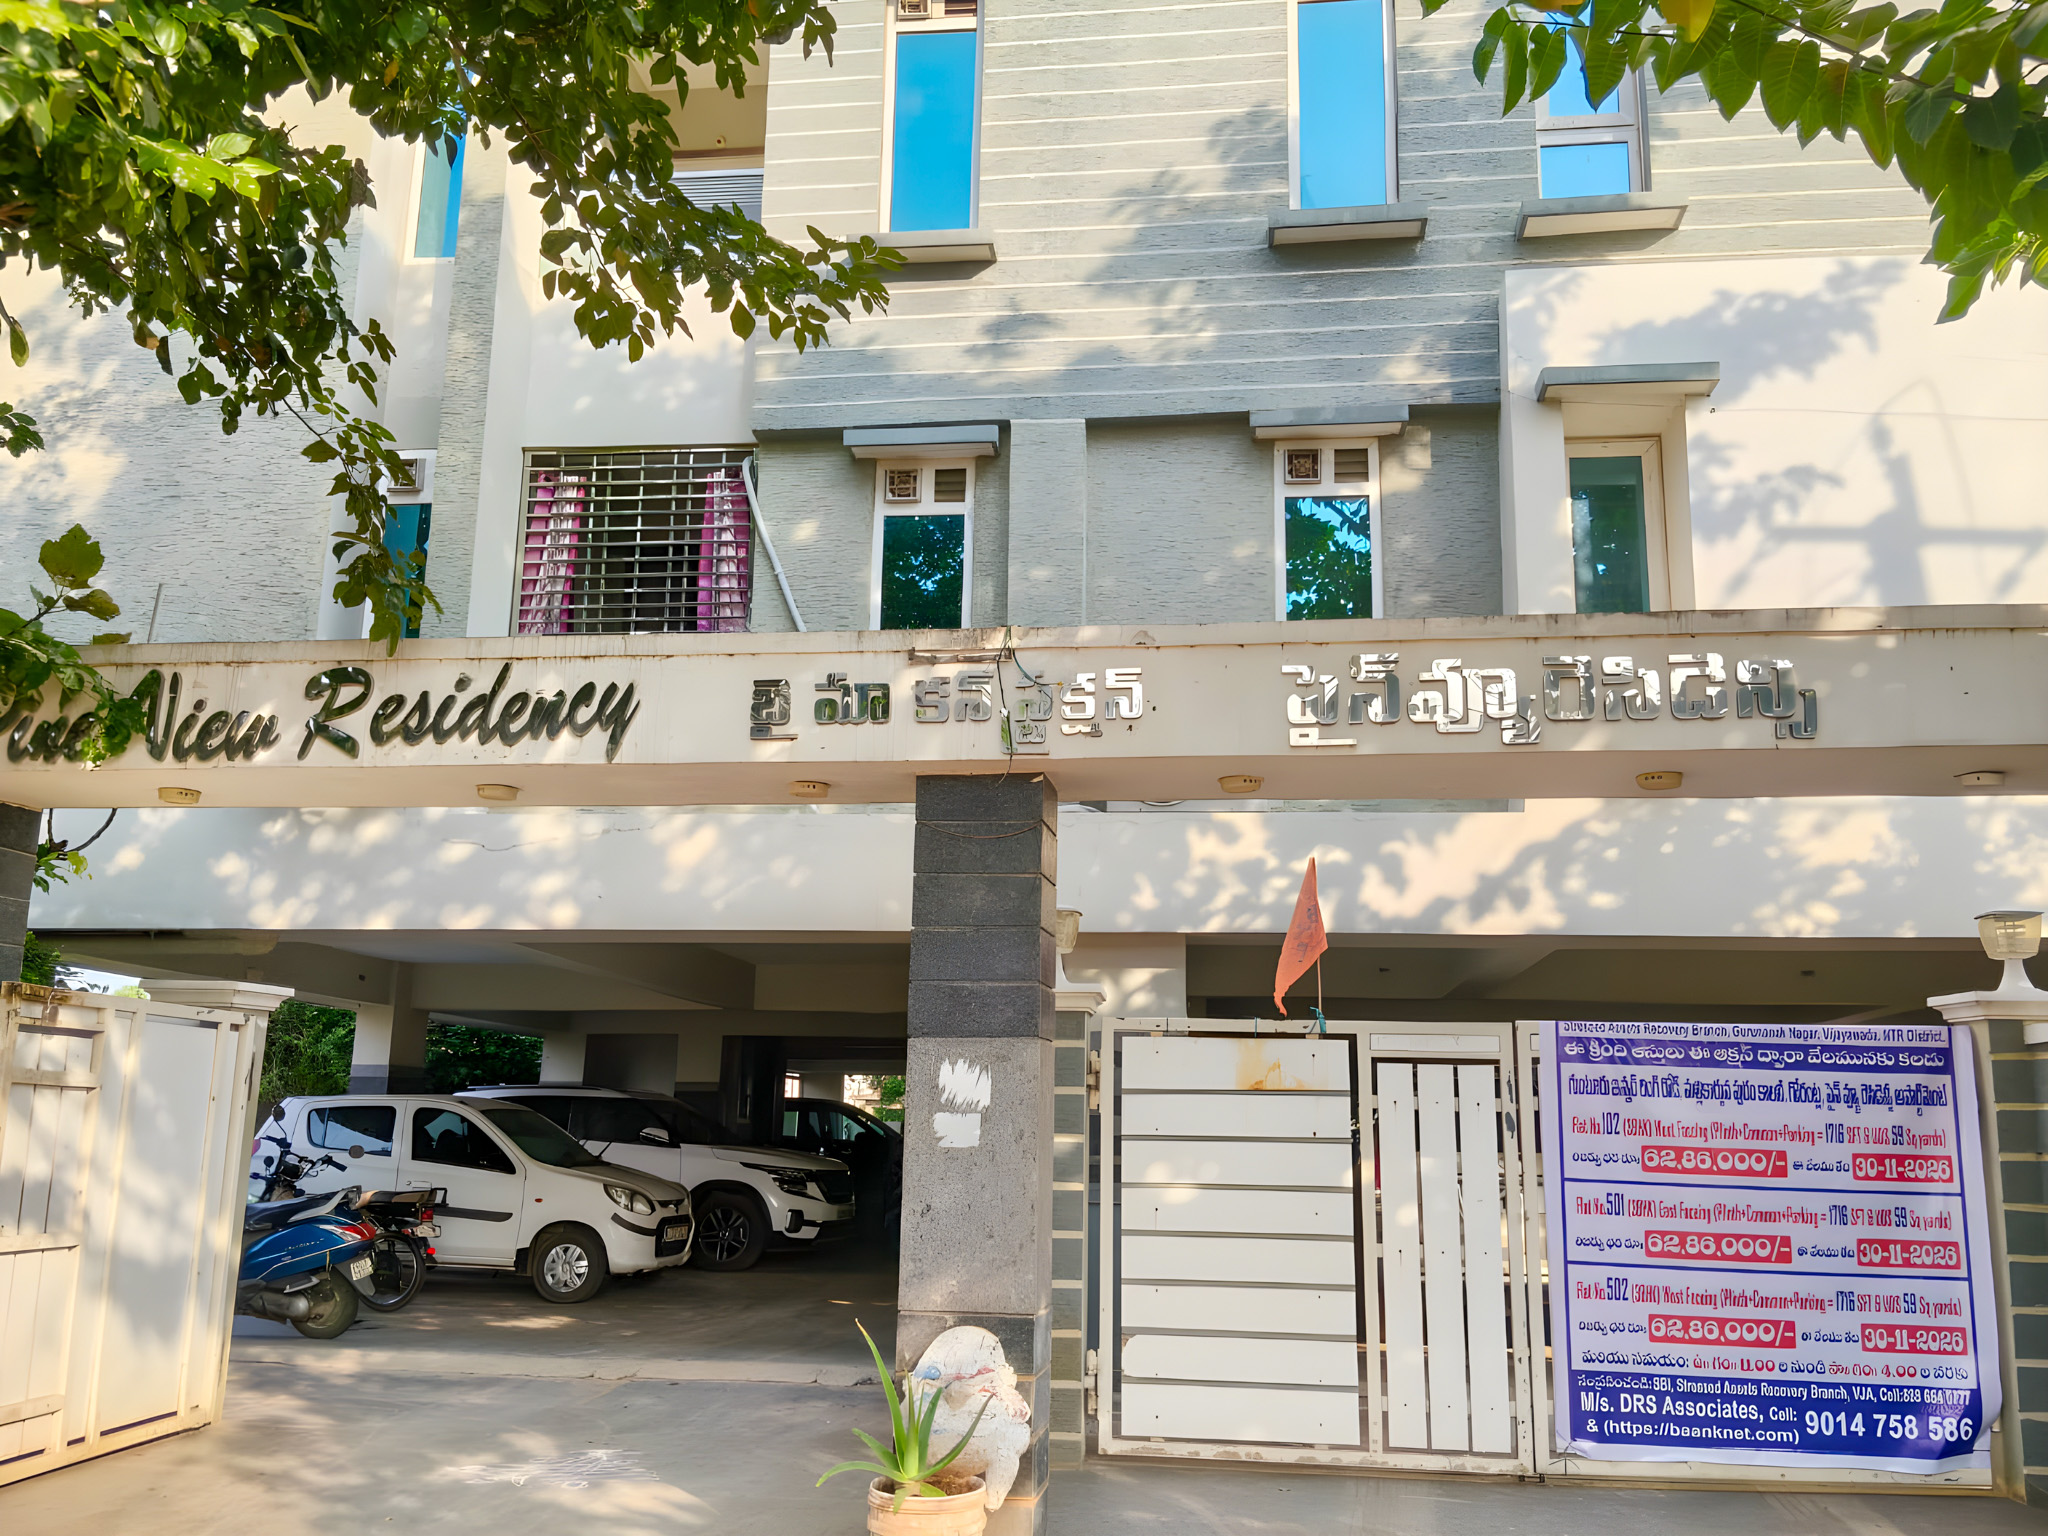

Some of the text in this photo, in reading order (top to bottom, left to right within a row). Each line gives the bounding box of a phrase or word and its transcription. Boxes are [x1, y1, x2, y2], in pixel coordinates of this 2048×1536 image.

[128, 668, 282, 763] View
[297, 661, 641, 764] Residency
[1854, 1157, 1951, 1181] 30-11-2026
[1859, 1243, 1958, 1266] 30-11-2026
[1864, 1328, 1964, 1353] 30-11-2026
[1881, 1364, 1917, 1378] 4.00
[1852, 1386, 1877, 1403] VJA,
[1580, 1392, 1615, 1412] M/s.
[1620, 1393, 1657, 1414] DRS
[1662, 1396, 1764, 1422] Associates,
[1805, 1410, 1866, 1437] 9014
[1873, 1413, 1919, 1438] 758
[1928, 1415, 1974, 1442] 586
[1586, 1418, 1599, 1432] &
